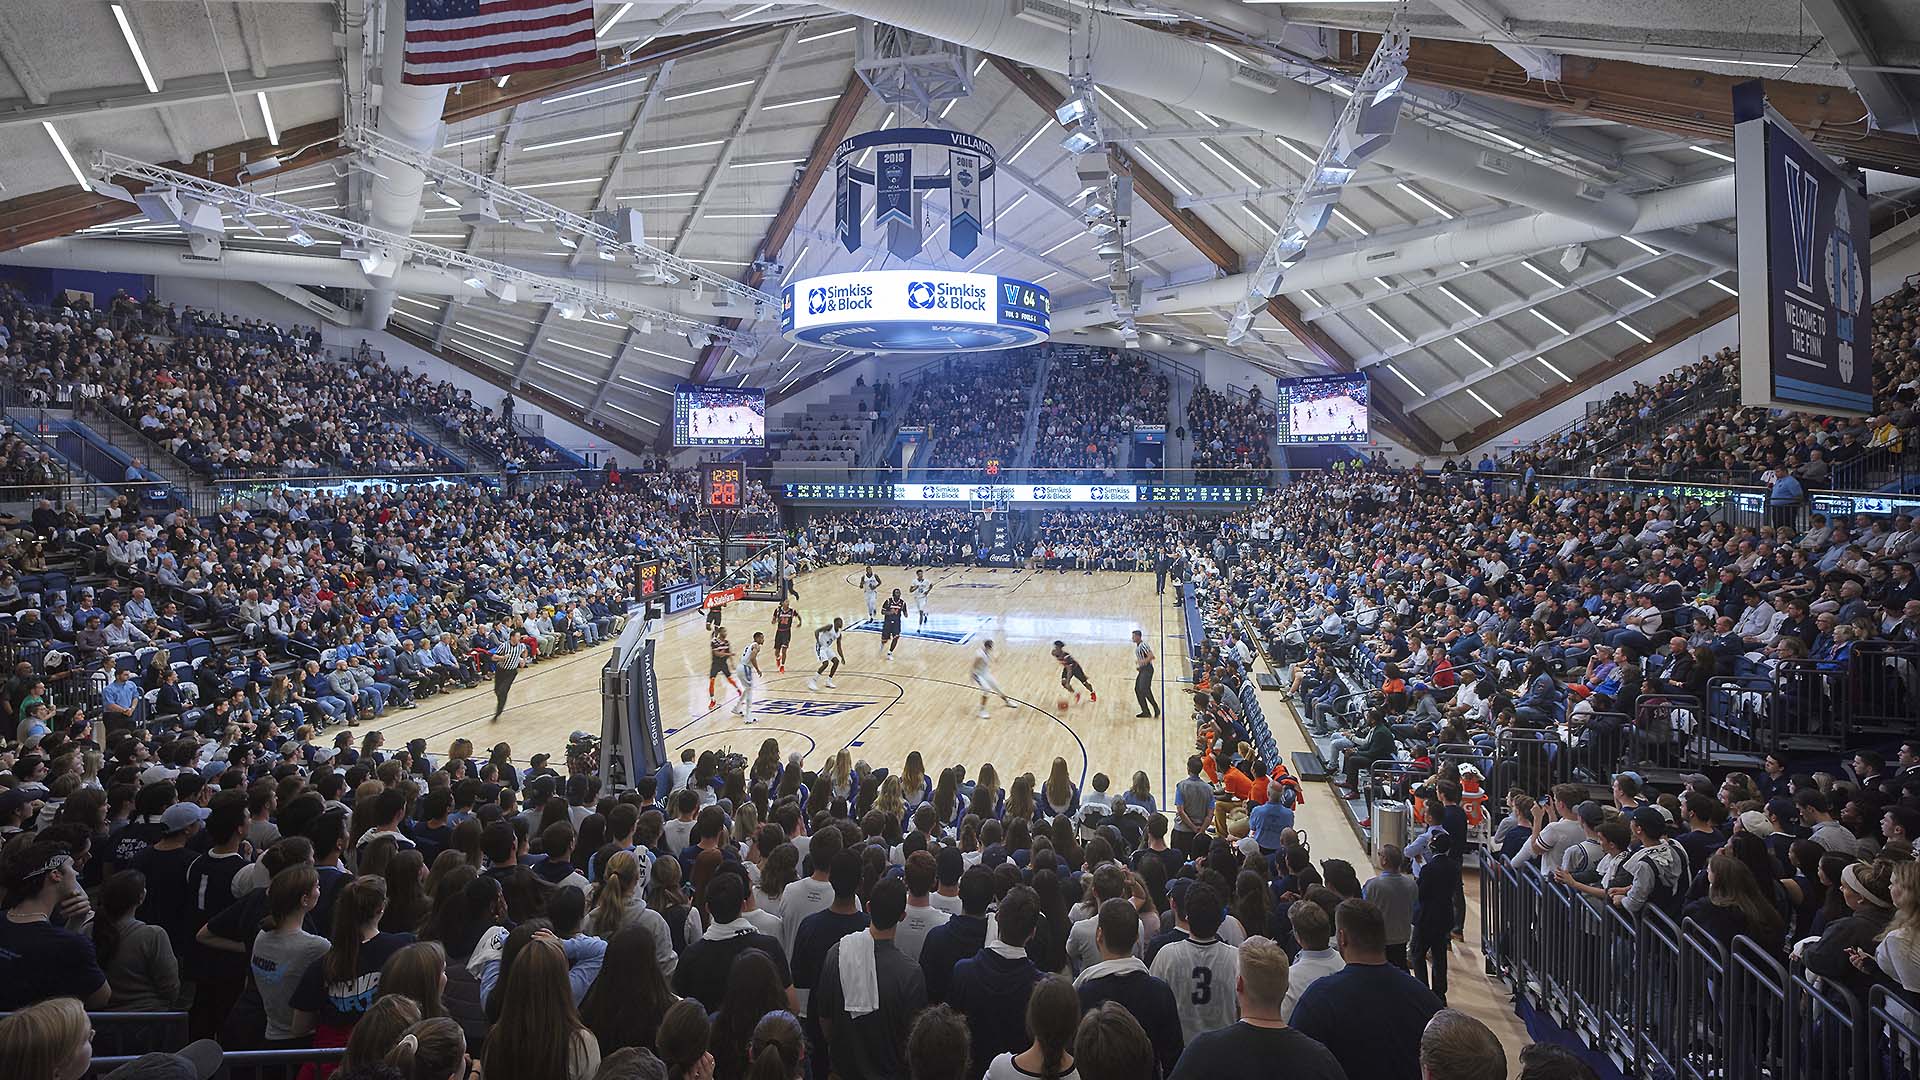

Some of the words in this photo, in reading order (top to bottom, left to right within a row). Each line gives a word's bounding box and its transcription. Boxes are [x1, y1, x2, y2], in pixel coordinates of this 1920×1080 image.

[884, 153, 904, 163] 2018
[1785, 155, 1818, 293] V
[828, 284, 872, 298] Simkiss
[937, 283, 986, 298] Simkiss
[1023, 290, 1035, 306] 64
[828, 298, 837, 311] &
[839, 297, 872, 310] Block
[937, 296, 948, 309] &
[951, 297, 986, 311] Block
[1785, 301, 1816, 333] WELCOME
[1817, 315, 1826, 336] TO
[1792, 329, 1804, 352] THE
[1806, 334, 1821, 358] FINN
[712, 470, 738, 482] 12:39
[642, 566, 656, 578] 12:39
[1464, 803, 1472, 812] G
[198, 873, 208, 910] 1
[1192, 966, 1212, 1005] 3
